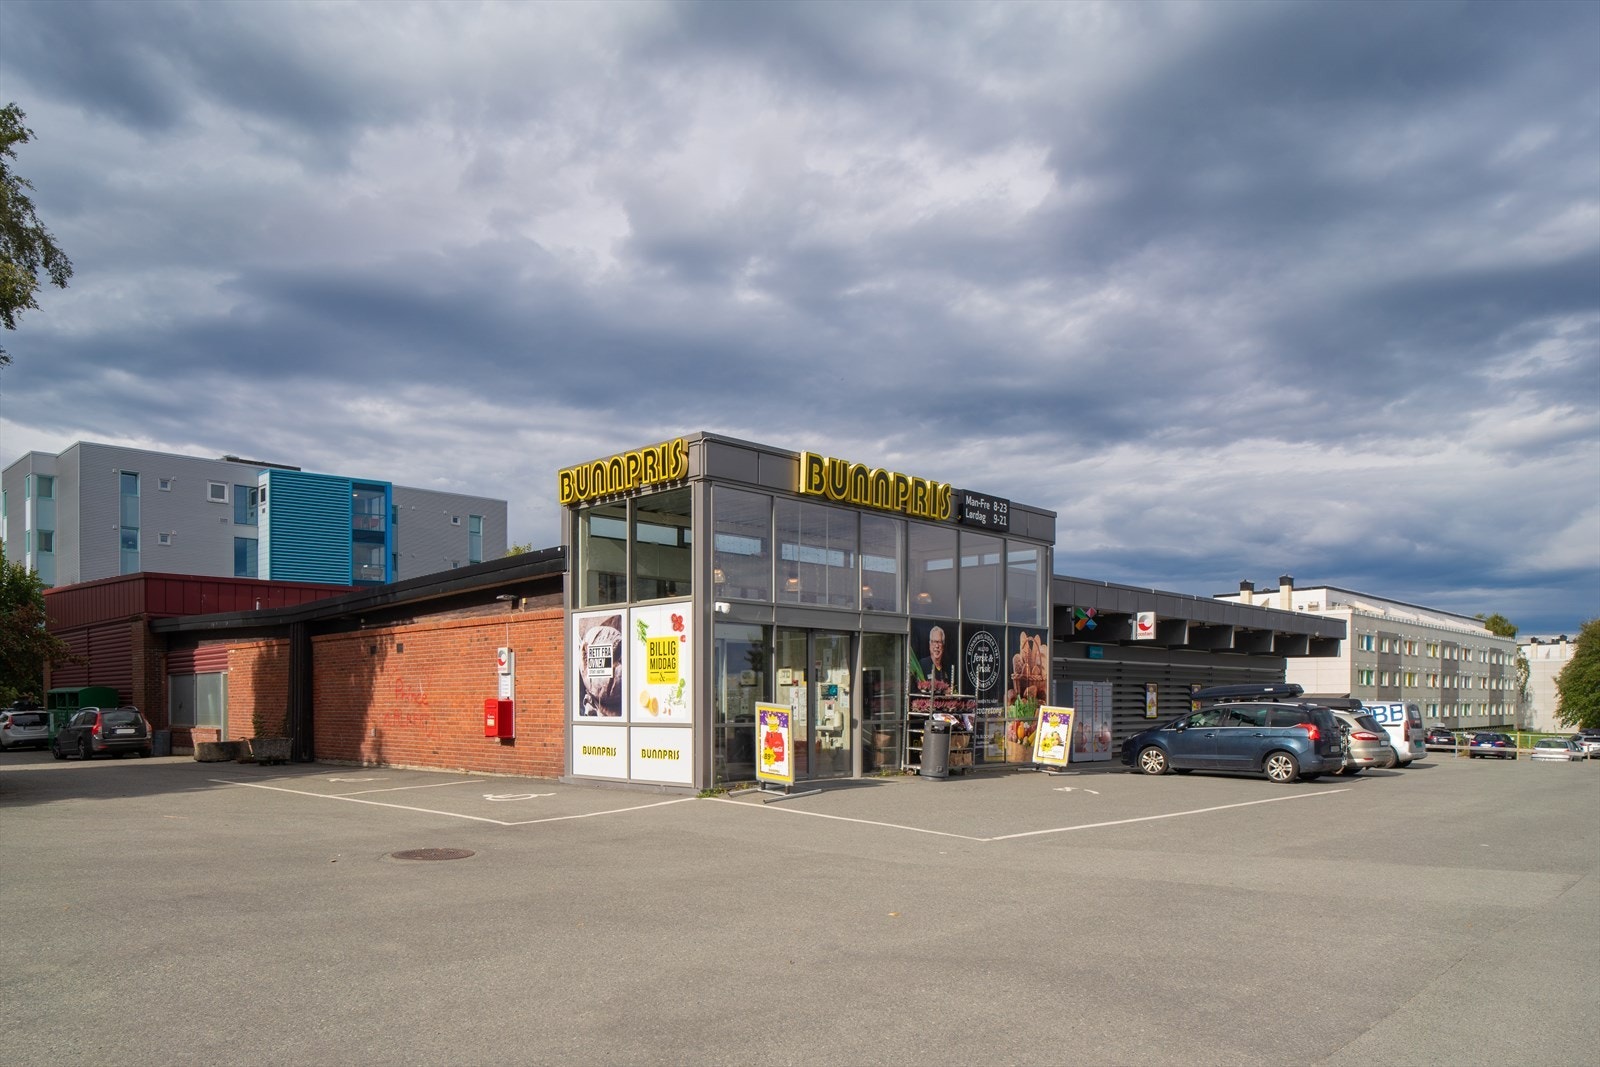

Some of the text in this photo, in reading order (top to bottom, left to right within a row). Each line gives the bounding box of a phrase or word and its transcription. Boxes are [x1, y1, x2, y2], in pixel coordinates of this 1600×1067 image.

[559, 438, 688, 505] BUNNPRIS
[800, 451, 951, 520] BUNNPRIS
[965, 495, 1008, 513] Man-Fre 8-23
[993, 514, 1007, 526] 9-21
[589, 647, 611, 657] RETT FRA
[650, 641, 676, 656] BILLIG
[650, 657, 676, 670] MIDDAG
[582, 745, 617, 757] BUNNPRIS
[641, 748, 680, 760] BUNNPRIS
